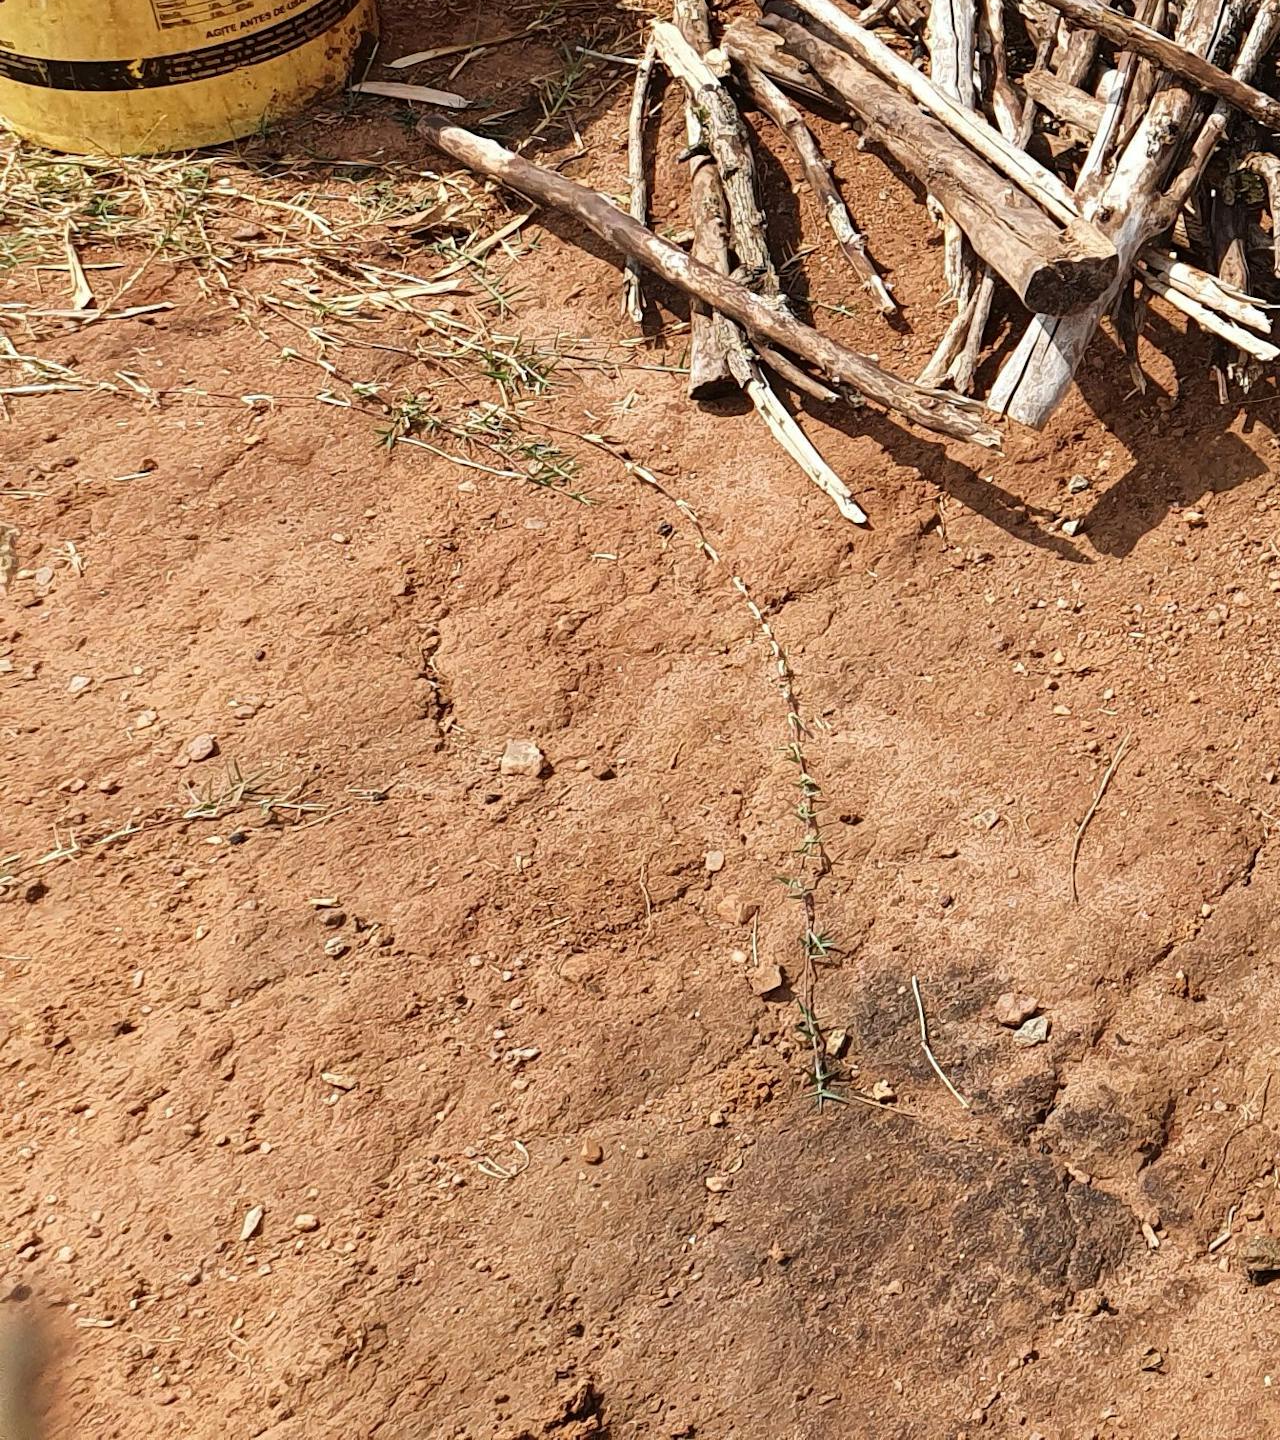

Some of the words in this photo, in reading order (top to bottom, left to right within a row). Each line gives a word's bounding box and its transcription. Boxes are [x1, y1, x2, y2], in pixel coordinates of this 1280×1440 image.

[205, 23, 237, 39] AGITE
[239, 11, 272, 30] ANTES
[272, 4, 286, 18] DE
